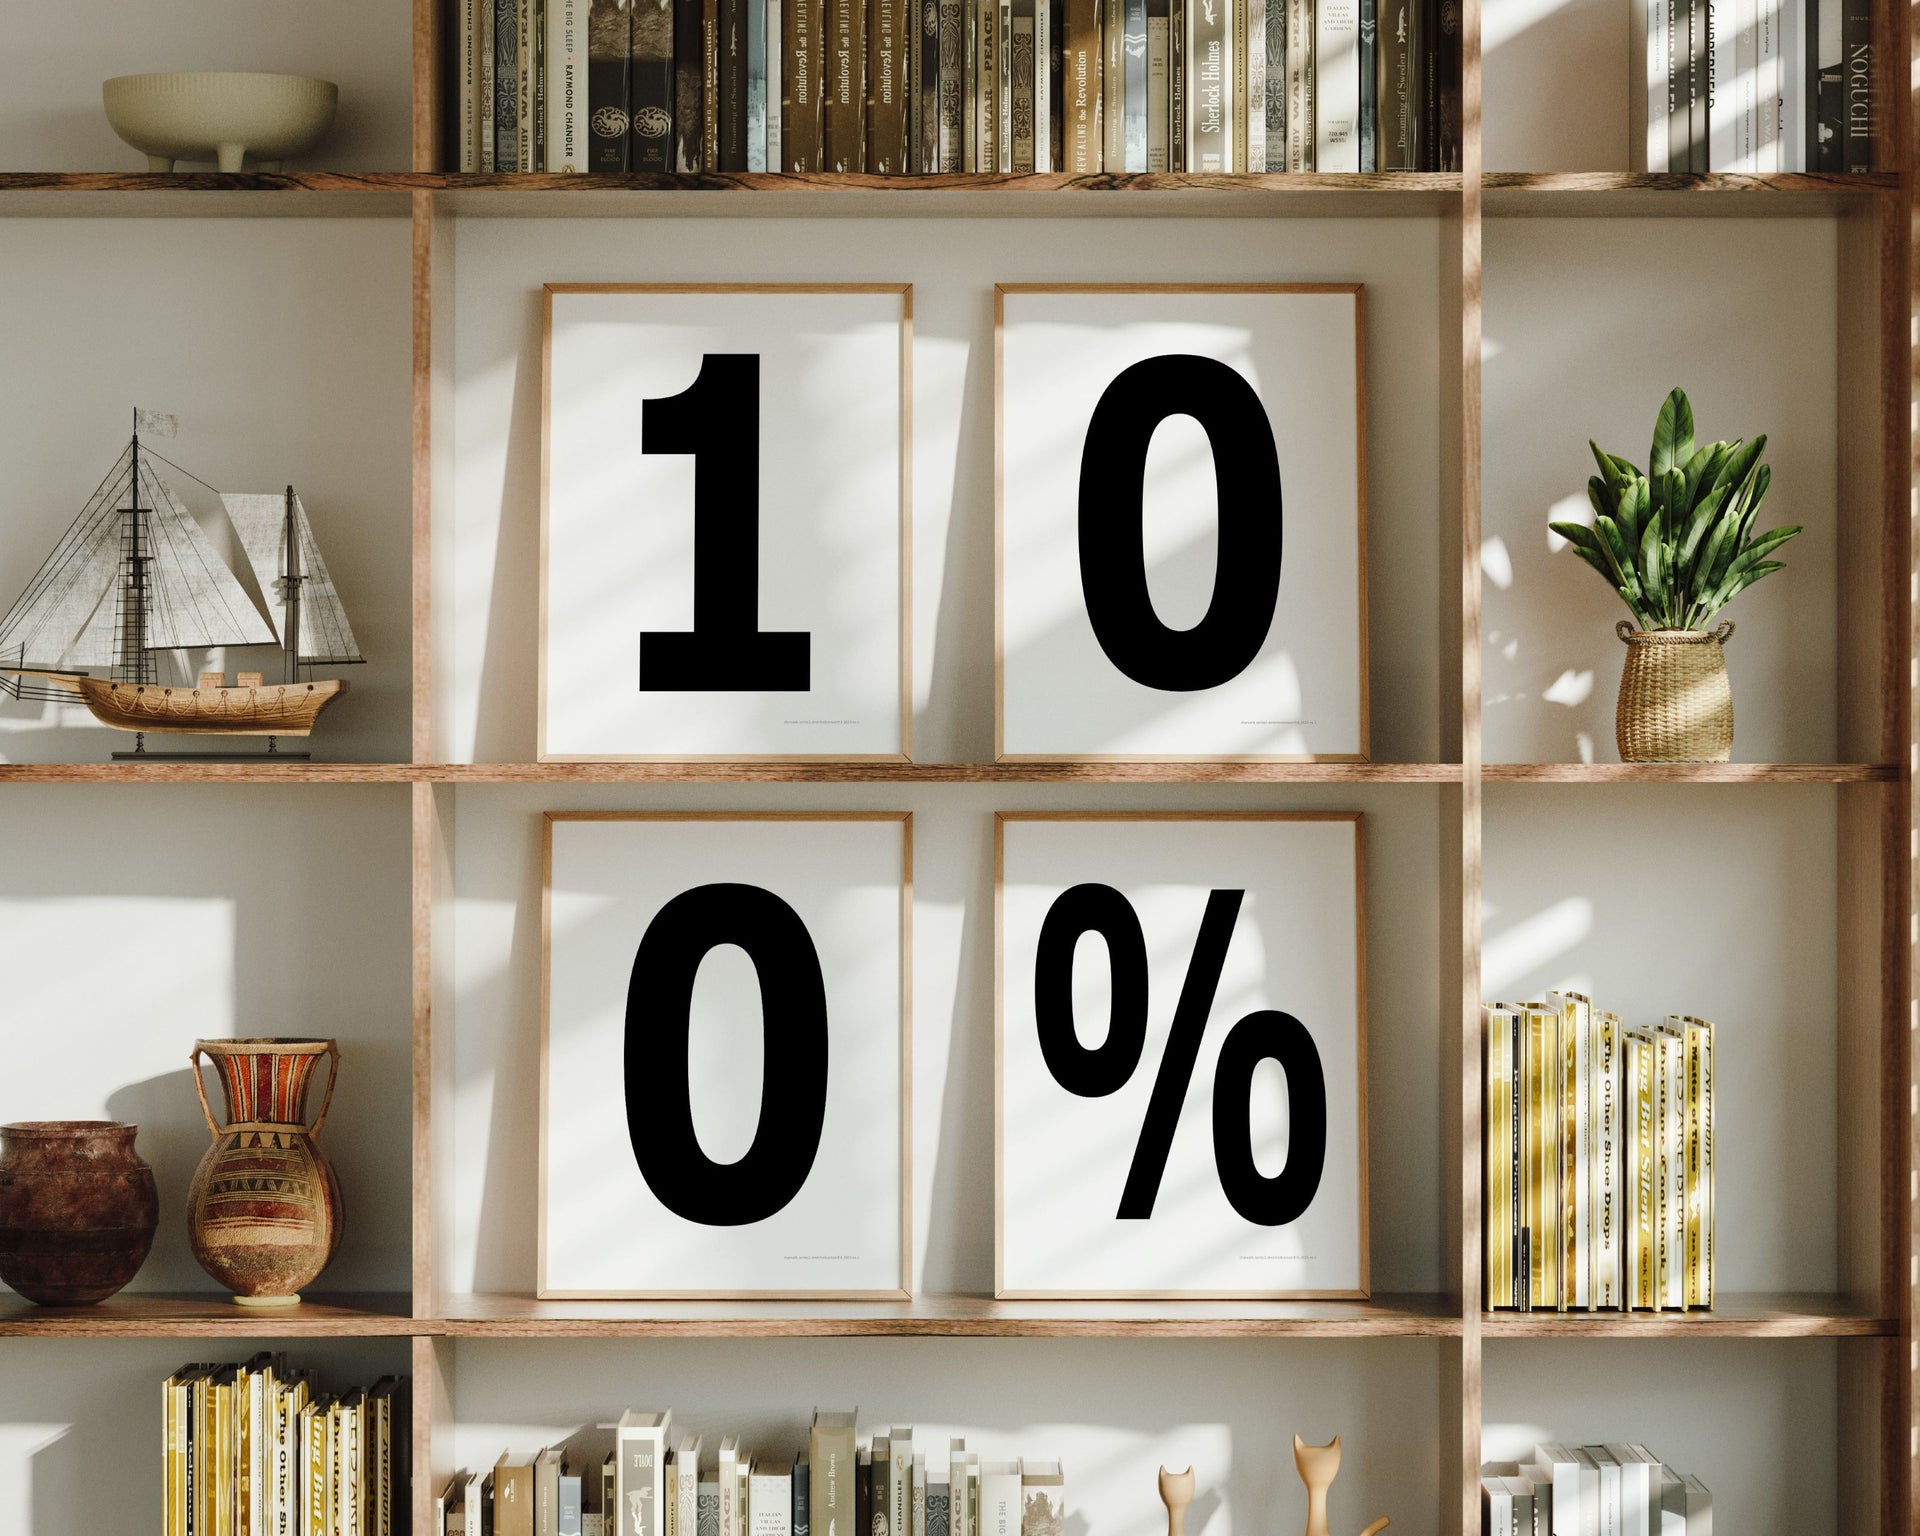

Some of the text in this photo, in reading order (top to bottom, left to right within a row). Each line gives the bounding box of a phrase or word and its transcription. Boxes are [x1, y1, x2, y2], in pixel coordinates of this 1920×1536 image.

[565, 12, 573, 26] BIG
[565, 29, 573, 53] SLEEP
[984, 12, 992, 71] PEACE
[565, 64, 573, 109] RAYMOND
[984, 89, 992, 137] WAR
[1076, 51, 1087, 172] REVEALING the Revolution
[1201, 40, 1220, 133] Sherlock Holmes
[1398, 53, 1406, 148] Dreaming of Sweden
[1850, 44, 1868, 138] NOGUCHI
[565, 112, 573, 158] CHANDLER
[640, 354, 811, 691] 1
[1079, 354, 1283, 692] 0
[624, 882, 829, 1227] 0
[1035, 882, 1327, 1226] %
[1640, 1044, 1650, 1093] ing
[1641, 1099, 1650, 1149] But
[1691, 1108, 1697, 1125] of
[1641, 1154, 1650, 1233] Silent
[279, 1407, 287, 1445] The
[312, 1417, 323, 1466] ing
[279, 1450, 287, 1507] Other
[313, 1470, 323, 1520] But
[828, 1453, 836, 1509] Andrew Brown
